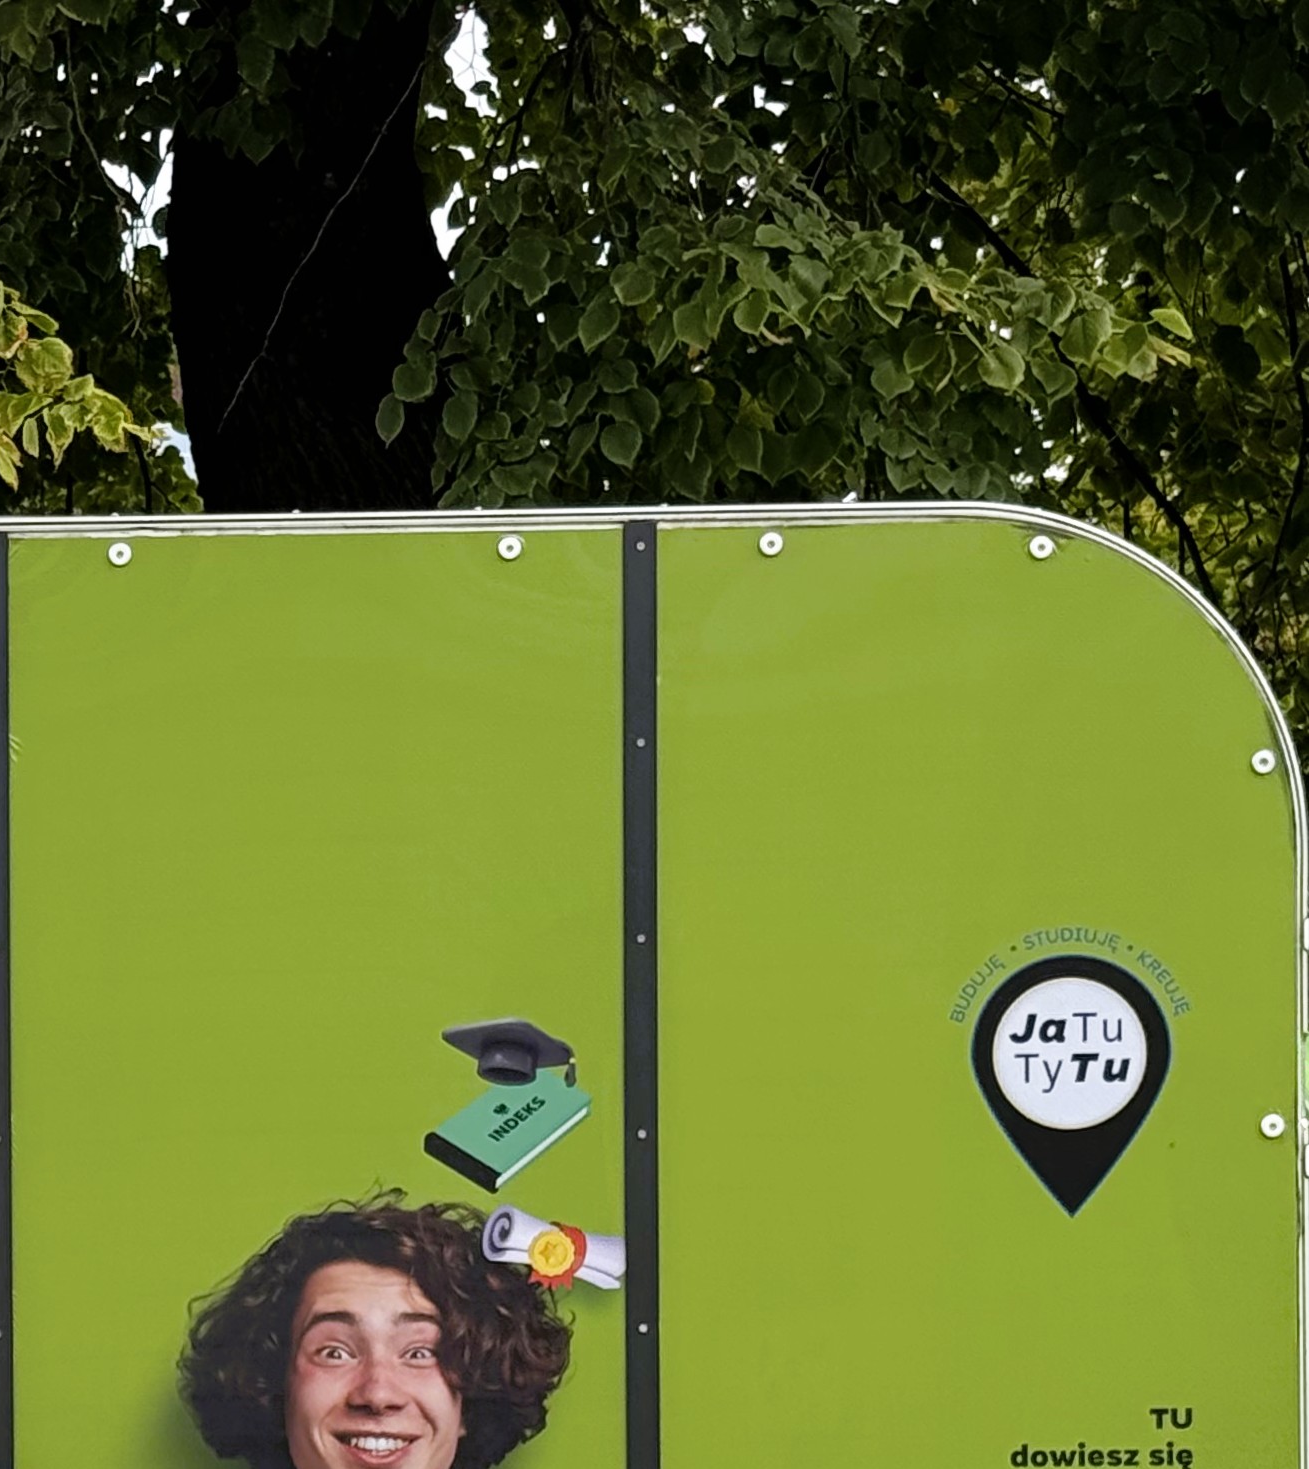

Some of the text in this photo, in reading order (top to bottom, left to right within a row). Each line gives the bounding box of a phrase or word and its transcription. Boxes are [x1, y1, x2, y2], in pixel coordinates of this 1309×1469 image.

[949, 927, 1192, 1024] BUDUJĘ STUDIUJĘ KREUJĘ
[488, 1096, 546, 1142] INDEKS
[1149, 1407, 1193, 1430] TU
[1010, 1442, 1140, 1468] dowiesz
